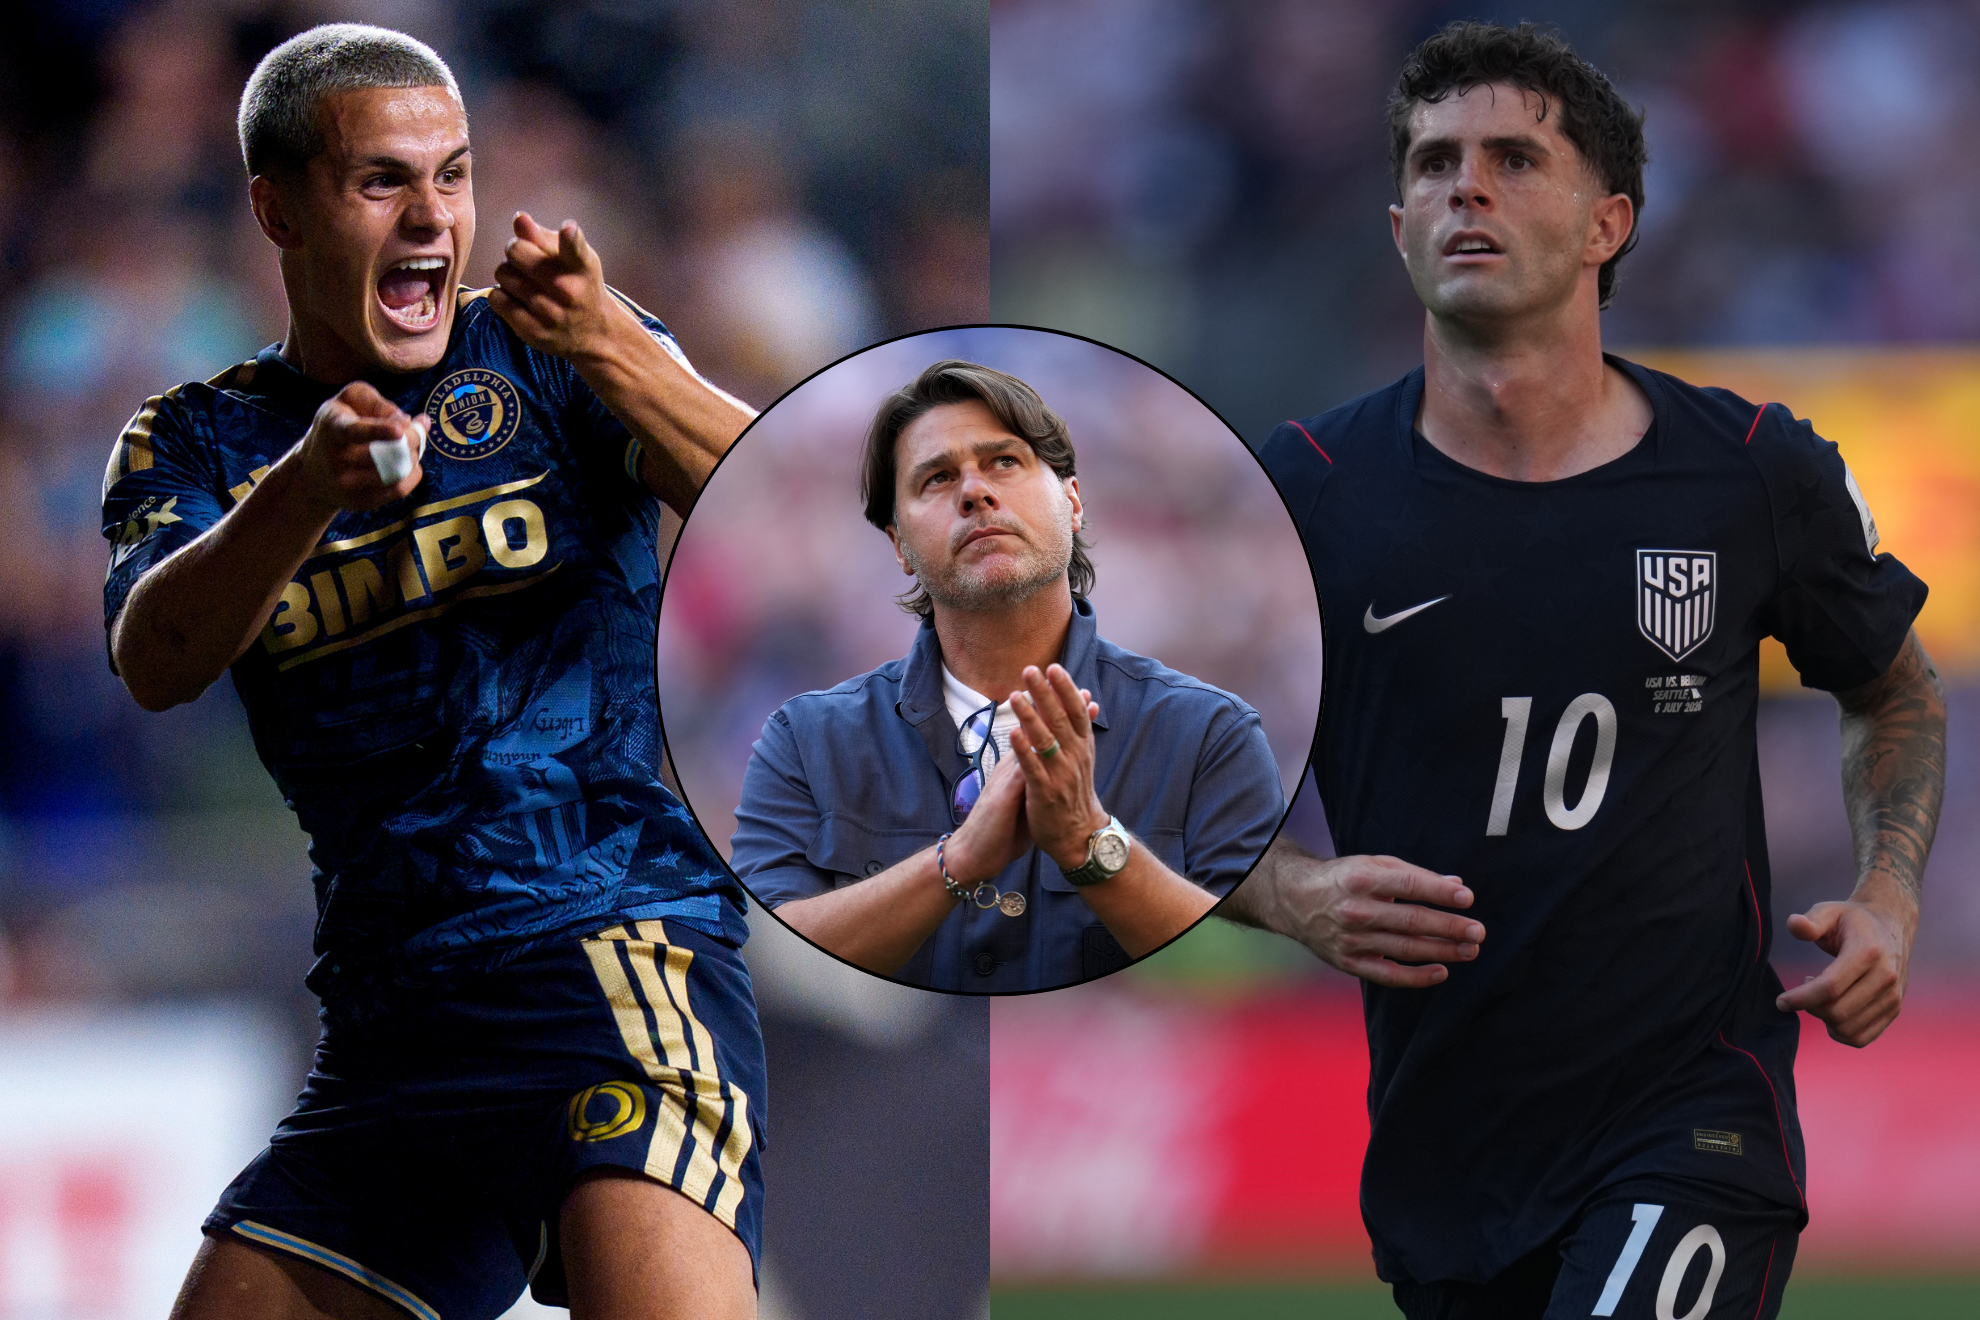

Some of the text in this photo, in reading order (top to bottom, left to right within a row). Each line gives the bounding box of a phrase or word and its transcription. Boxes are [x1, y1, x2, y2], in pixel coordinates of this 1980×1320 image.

[450, 392, 486, 413] UNION
[259, 499, 548, 655] BIMBO
[1643, 556, 1710, 598] USA
[1645, 676, 1663, 688] USA
[1652, 688, 1690, 701] SEATTLE,
[1654, 702, 1661, 713] 6
[1662, 701, 1684, 713] JULY
[1485, 692, 1618, 836] 10
[1590, 1203, 1726, 1320] 10
